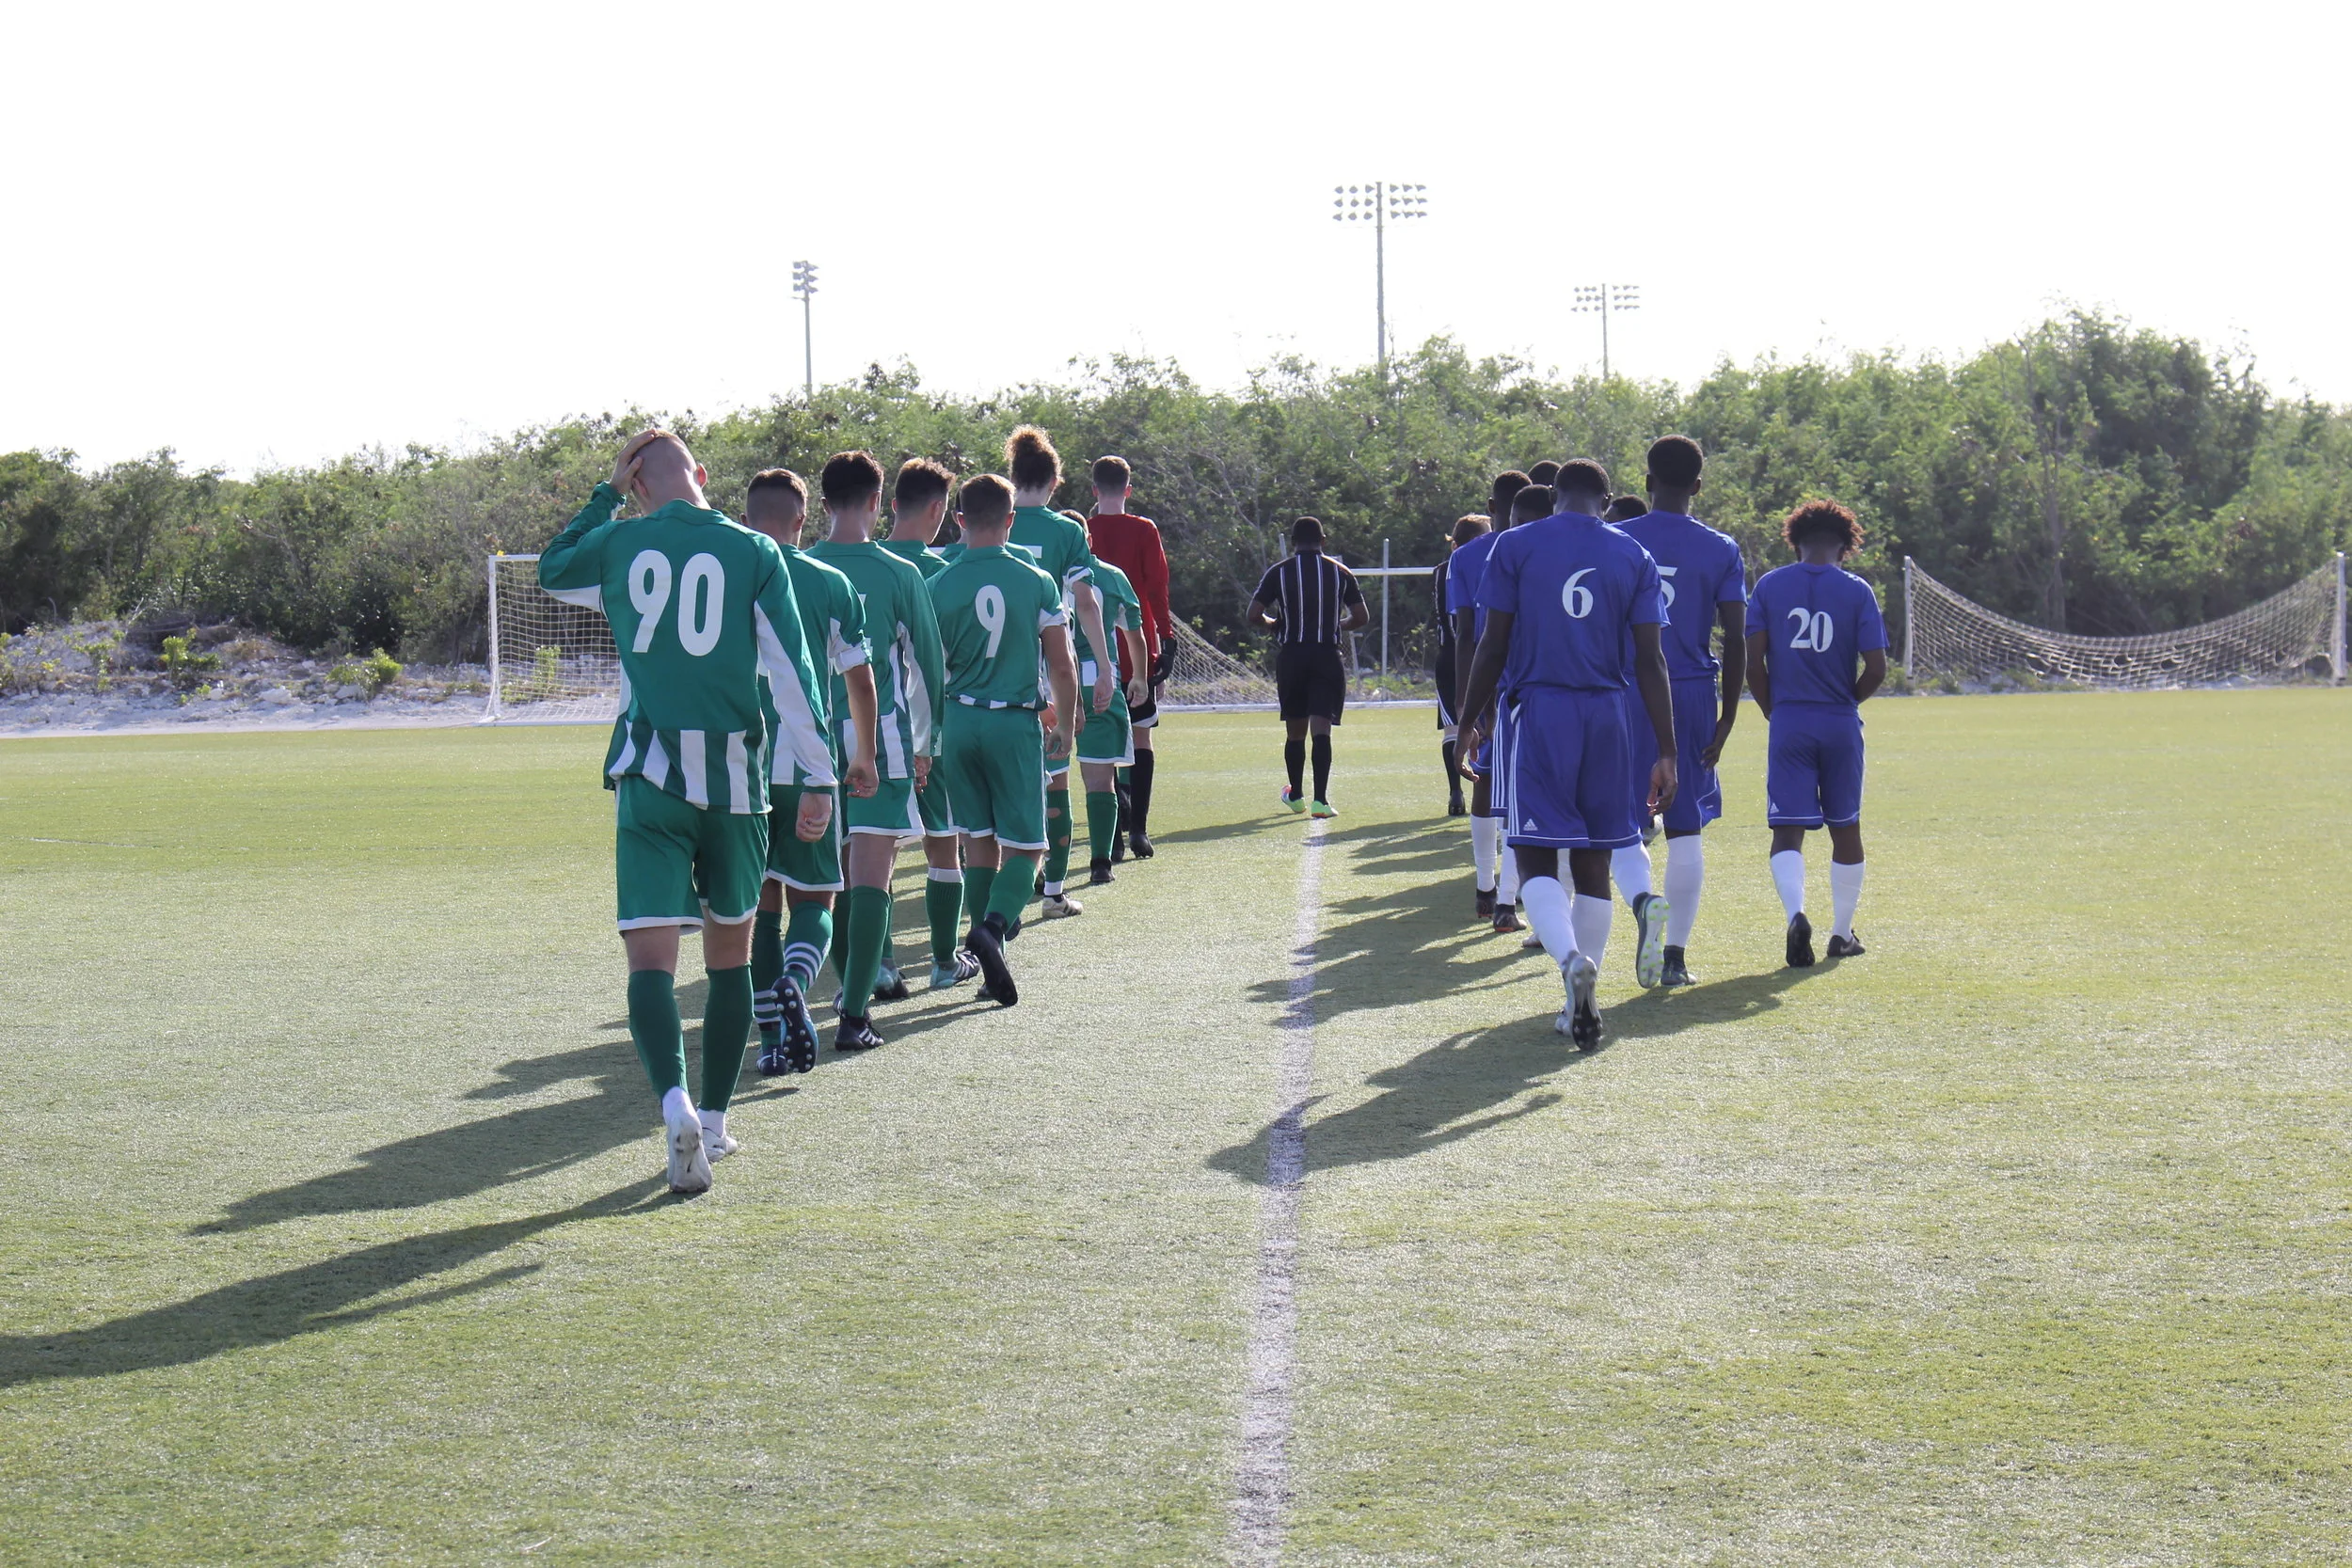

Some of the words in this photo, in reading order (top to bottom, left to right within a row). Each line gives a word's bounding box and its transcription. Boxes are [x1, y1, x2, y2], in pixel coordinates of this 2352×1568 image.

[628, 549, 725, 657] 90
[975, 584, 1006, 658] 9
[1562, 567, 1597, 619] 6
[1787, 607, 1834, 653] 20
